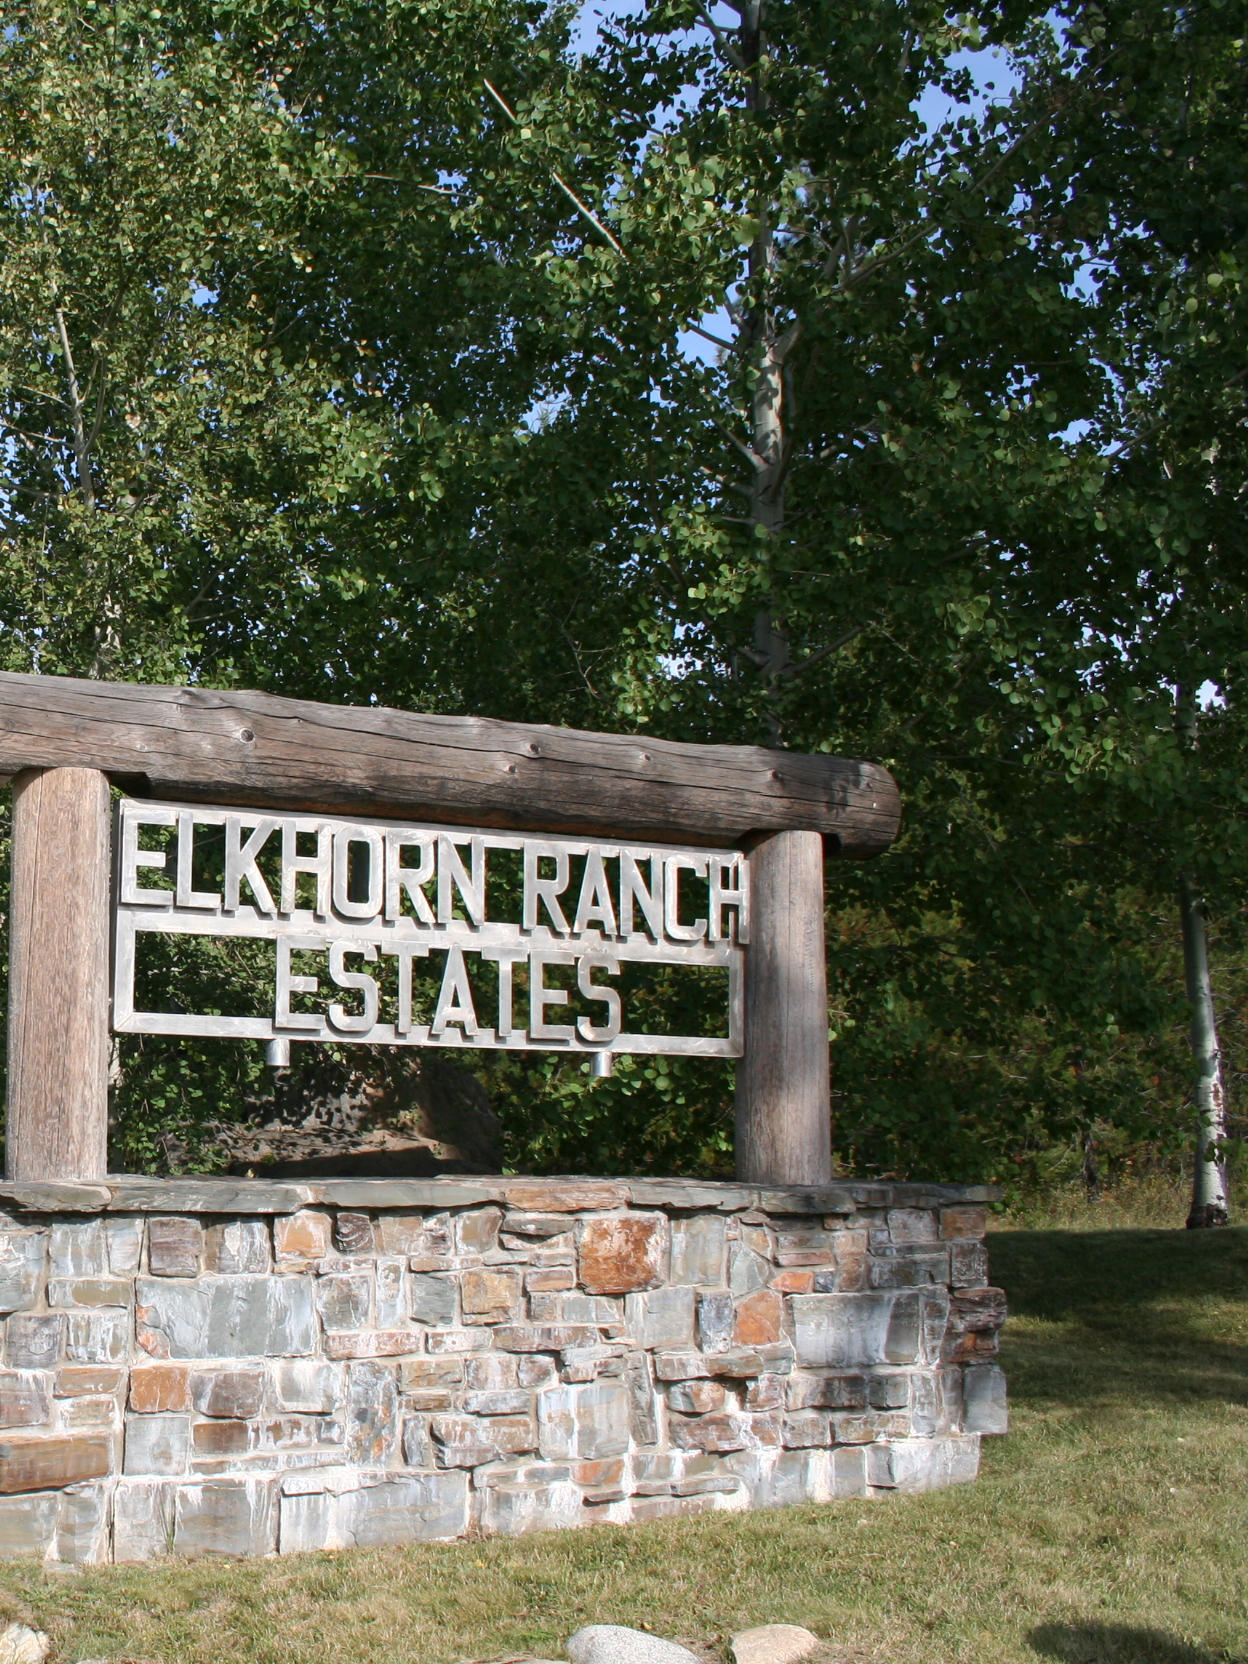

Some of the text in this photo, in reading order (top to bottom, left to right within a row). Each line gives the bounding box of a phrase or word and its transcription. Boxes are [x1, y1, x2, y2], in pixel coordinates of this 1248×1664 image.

[120, 807, 751, 945] ELKHORN RANCH
[275, 935, 621, 1043] ESTATES
